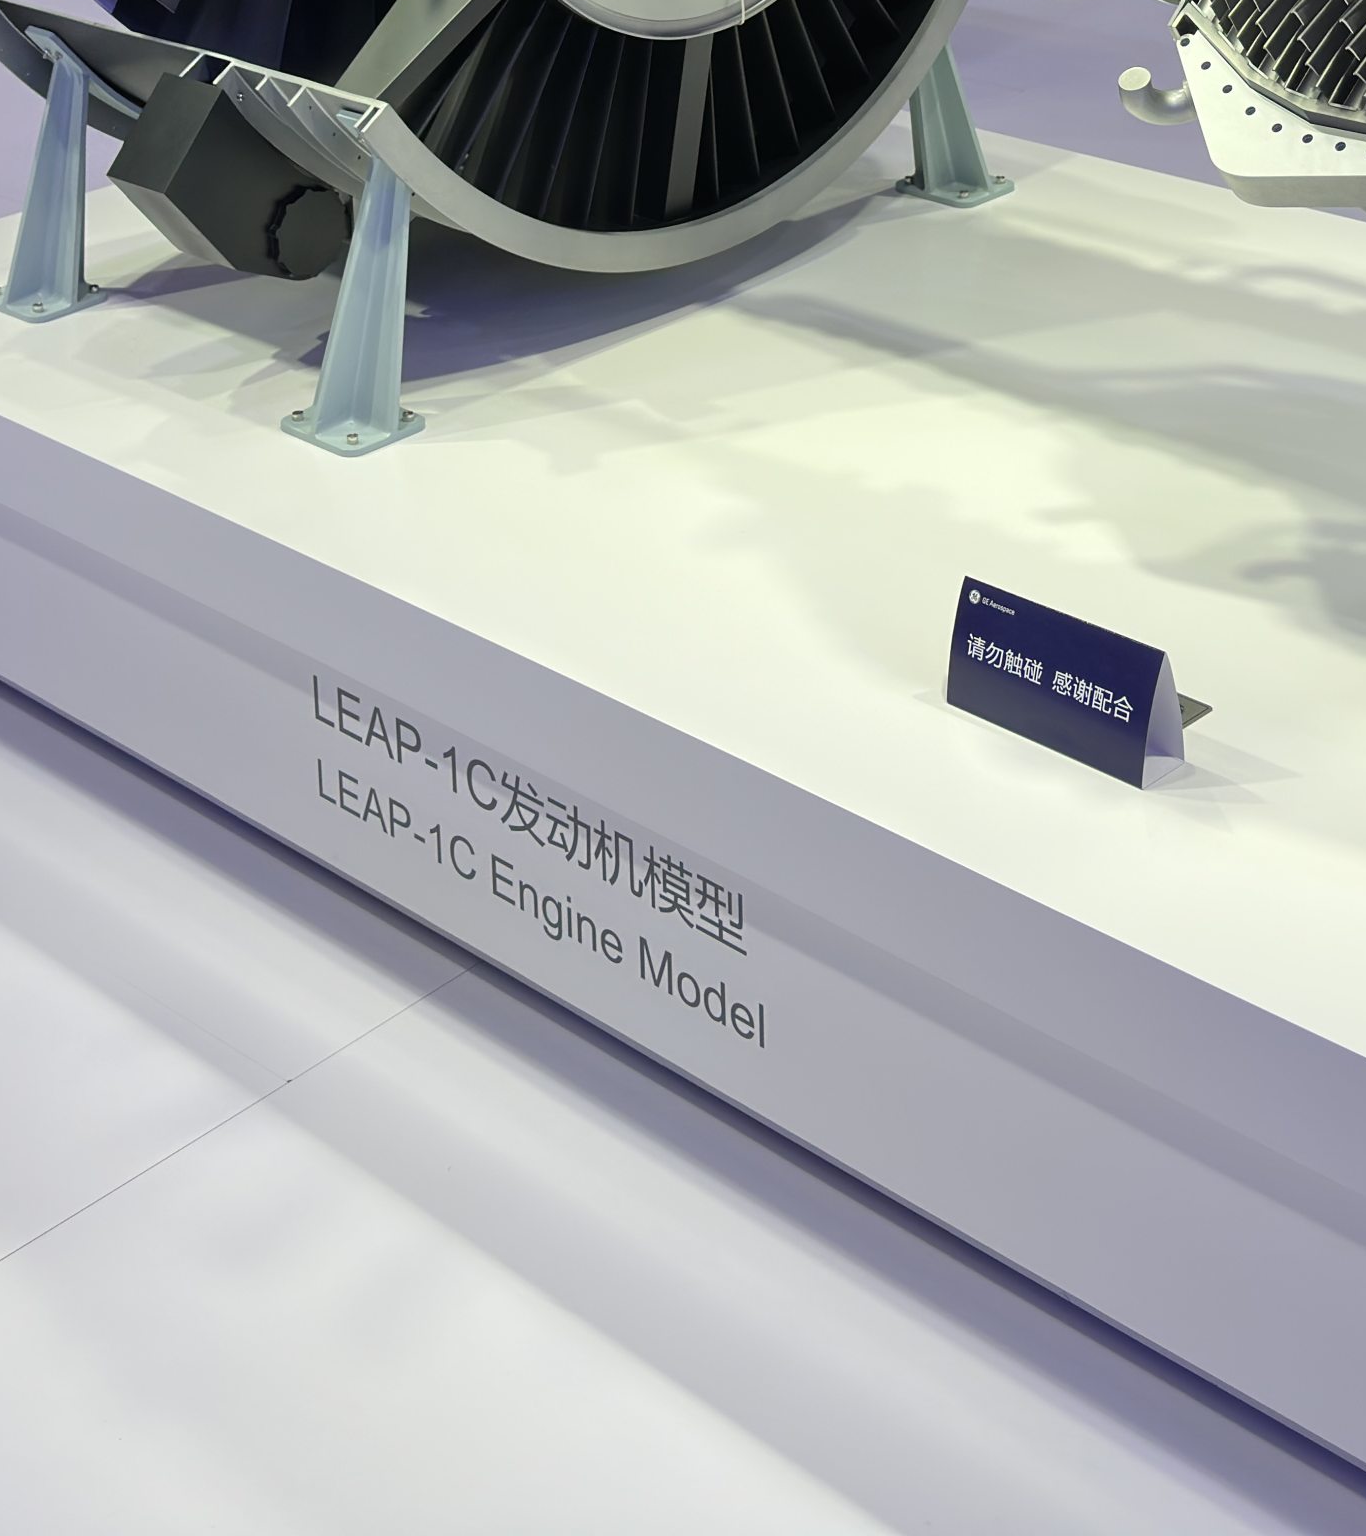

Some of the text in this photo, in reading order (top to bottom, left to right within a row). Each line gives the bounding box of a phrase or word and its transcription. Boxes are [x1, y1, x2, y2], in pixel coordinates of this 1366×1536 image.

[312, 674, 749, 957] LEAP-1C发动机模型
[966, 633, 1135, 723] 请勿触碰 感谢配合
[317, 758, 766, 1049] LEAP-1C Engine Model
